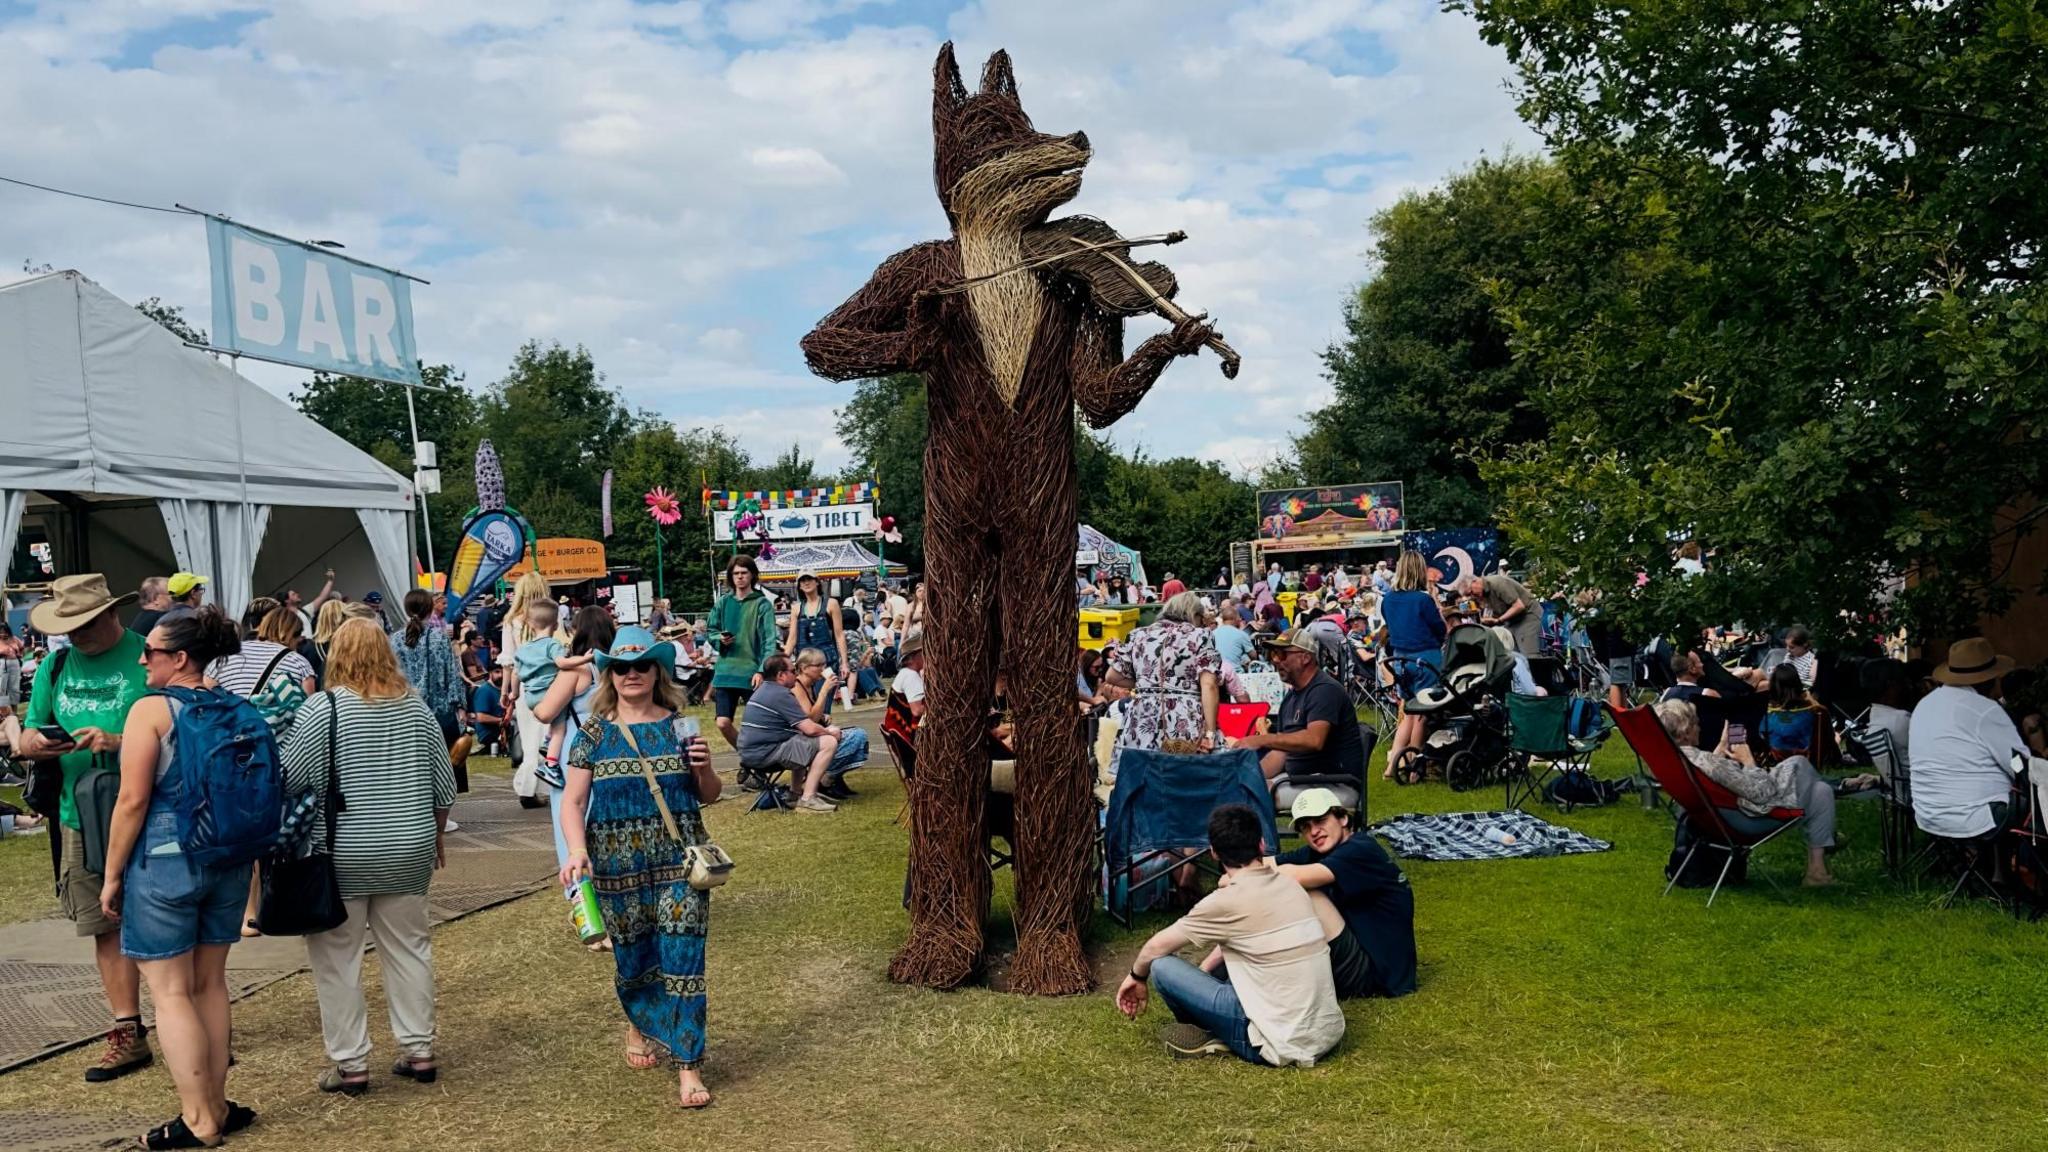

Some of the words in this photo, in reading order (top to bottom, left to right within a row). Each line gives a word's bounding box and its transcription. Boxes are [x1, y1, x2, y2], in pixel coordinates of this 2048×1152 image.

[231, 235, 400, 368] BAR
[813, 511, 862, 529] TIBET
[486, 533, 511, 553] TARKA
[556, 547, 585, 556] BURGER
